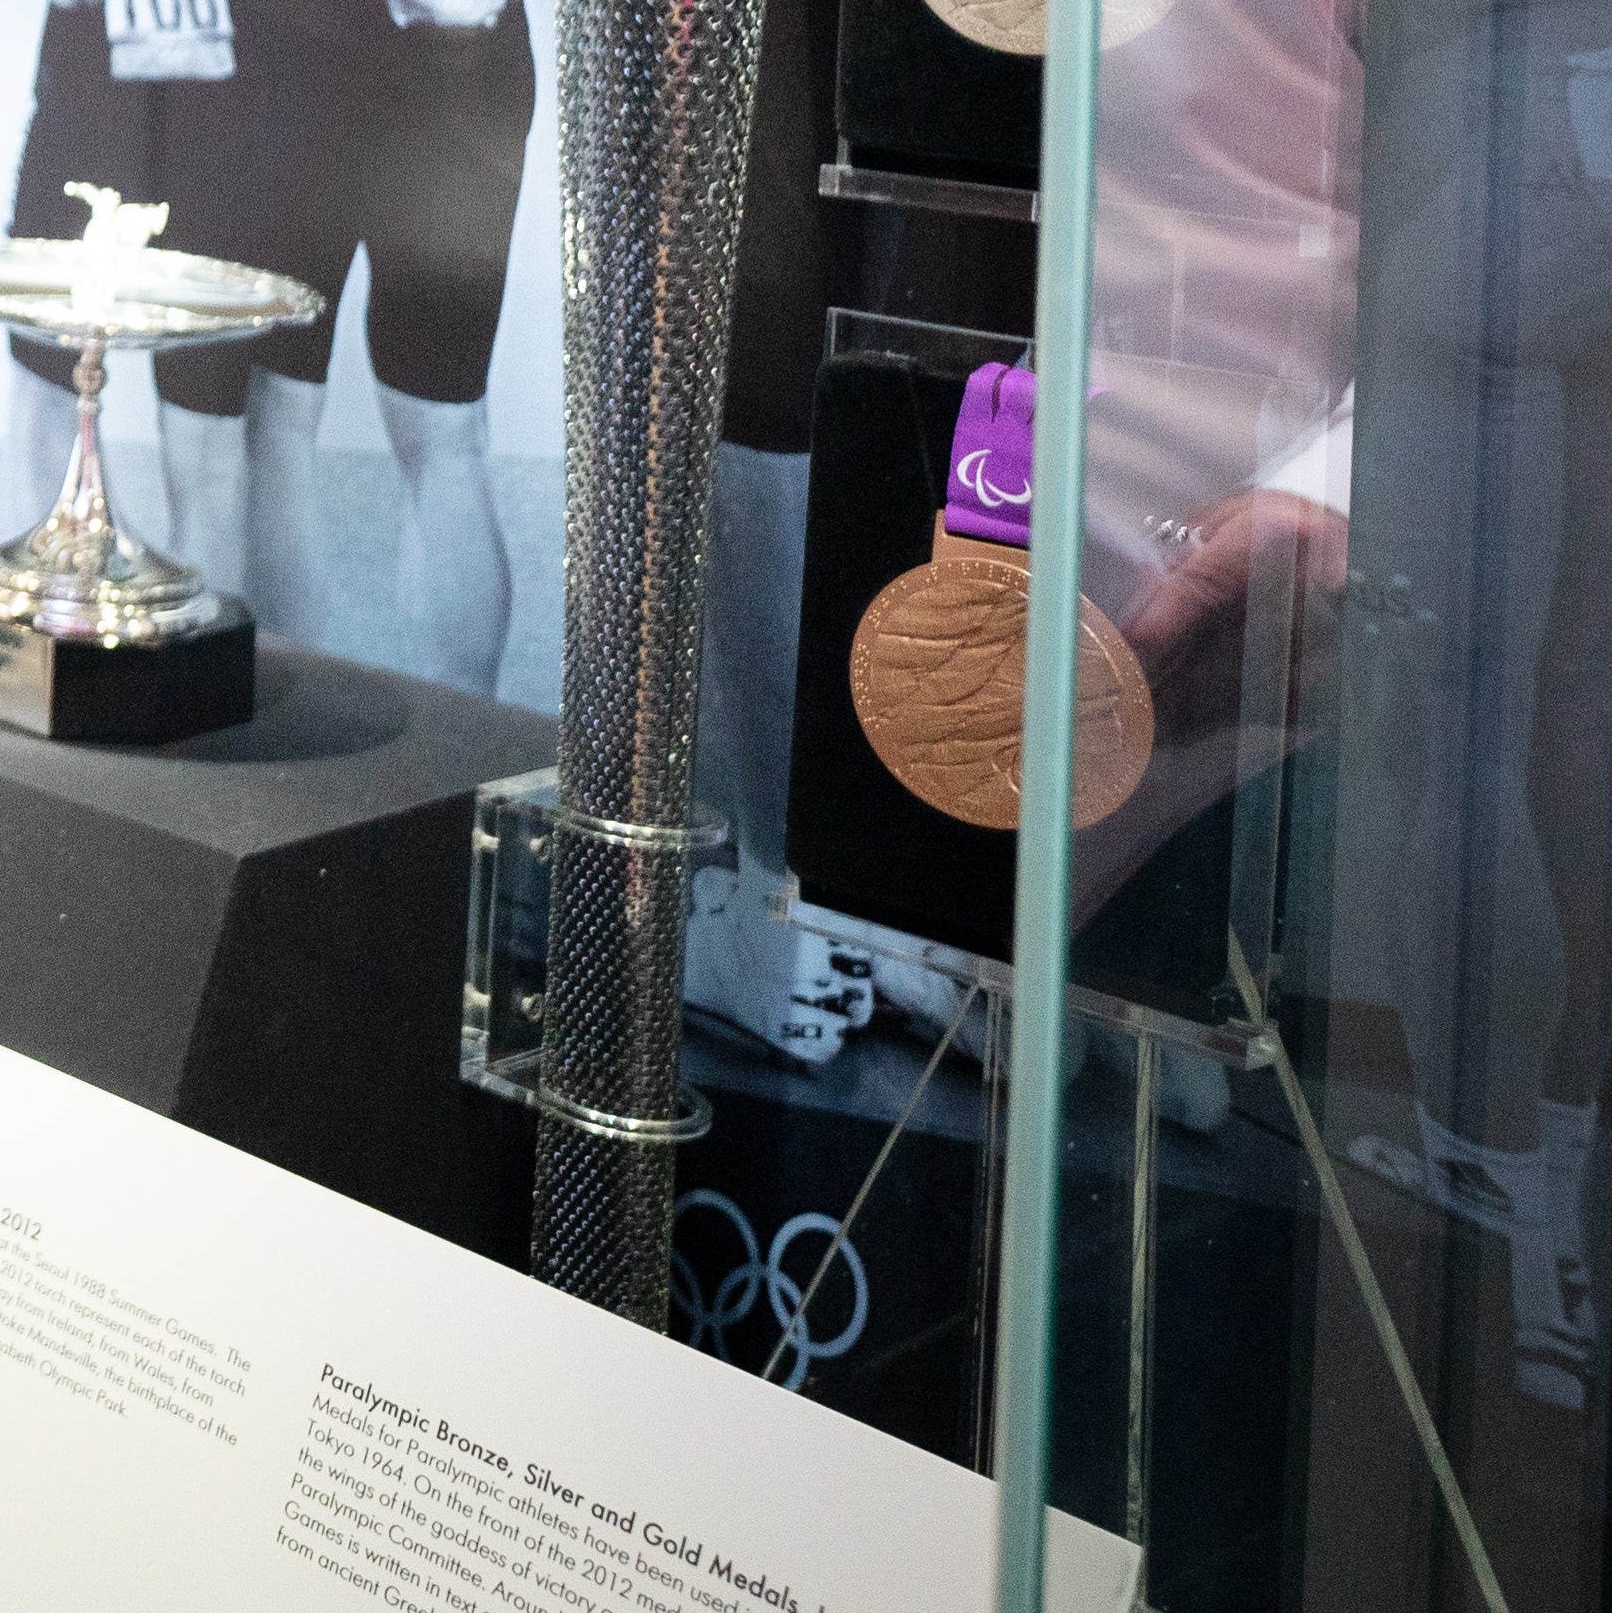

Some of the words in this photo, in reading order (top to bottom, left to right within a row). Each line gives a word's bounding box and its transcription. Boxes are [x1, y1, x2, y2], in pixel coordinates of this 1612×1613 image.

[0, 1207, 43, 1242] 2012
[14, 1292, 46, 1321] from
[98, 1334, 131, 1364] from
[134, 1352, 178, 1391] Wales,
[181, 1377, 214, 1408] from
[33, 1251, 71, 1282] Seoul
[73, 1271, 107, 1300] 1988
[107, 1288, 163, 1327] Summer
[164, 1317, 217, 1357] Games.
[226, 1347, 252, 1373] The
[33, 1279, 67, 1306] torch
[68, 1299, 132, 1338] represent
[132, 1331, 166, 1356] each
[167, 1348, 186, 1364] of
[185, 1354, 208, 1377] the
[209, 1368, 246, 1397] torch
[38, 1359, 94, 1400] Olympic
[95, 1388, 128, 1419] Park.
[103, 1366, 126, 1388] the
[126, 1376, 196, 1424] birthplace
[197, 1417, 215, 1433] of
[214, 1424, 238, 1447] the
[307, 1417, 356, 1458] Tokyo
[362, 1446, 407, 1486] 1964.
[413, 1474, 442, 1503] On
[445, 1491, 474, 1519] the
[477, 1505, 521, 1542] front
[523, 1534, 546, 1554] of
[547, 1542, 577, 1571] the
[580, 1558, 634, 1600] 2012
[311, 1392, 374, 1438] Medals
[377, 1423, 403, 1450] for
[405, 1438, 505, 1503] Paralympic
[507, 1495, 579, 1541] athletes
[583, 1525, 631, 1566] have
[634, 1551, 685, 1593] been
[320, 1363, 430, 1434] Paralympic
[435, 1419, 514, 1479] Bronze,
[523, 1463, 585, 1508] Silver
[590, 1502, 637, 1535] and
[642, 1522, 703, 1568] Gold
[275, 1524, 315, 1561] from
[317, 1554, 380, 1596] ancient
[284, 1499, 344, 1546] Games
[347, 1534, 360, 1555] is
[365, 1547, 421, 1588] written
[424, 1576, 441, 1599] in
[445, 1587, 478, 1613] text
[290, 1471, 384, 1536] Paralympic
[387, 1524, 486, 1591] Committee.
[298, 1447, 324, 1473] the
[328, 1465, 375, 1500] wings
[378, 1491, 399, 1510] of
[400, 1499, 428, 1527] the
[430, 1520, 507, 1569] goddess
[511, 1560, 533, 1580] of
[535, 1572, 597, 1613] victory
